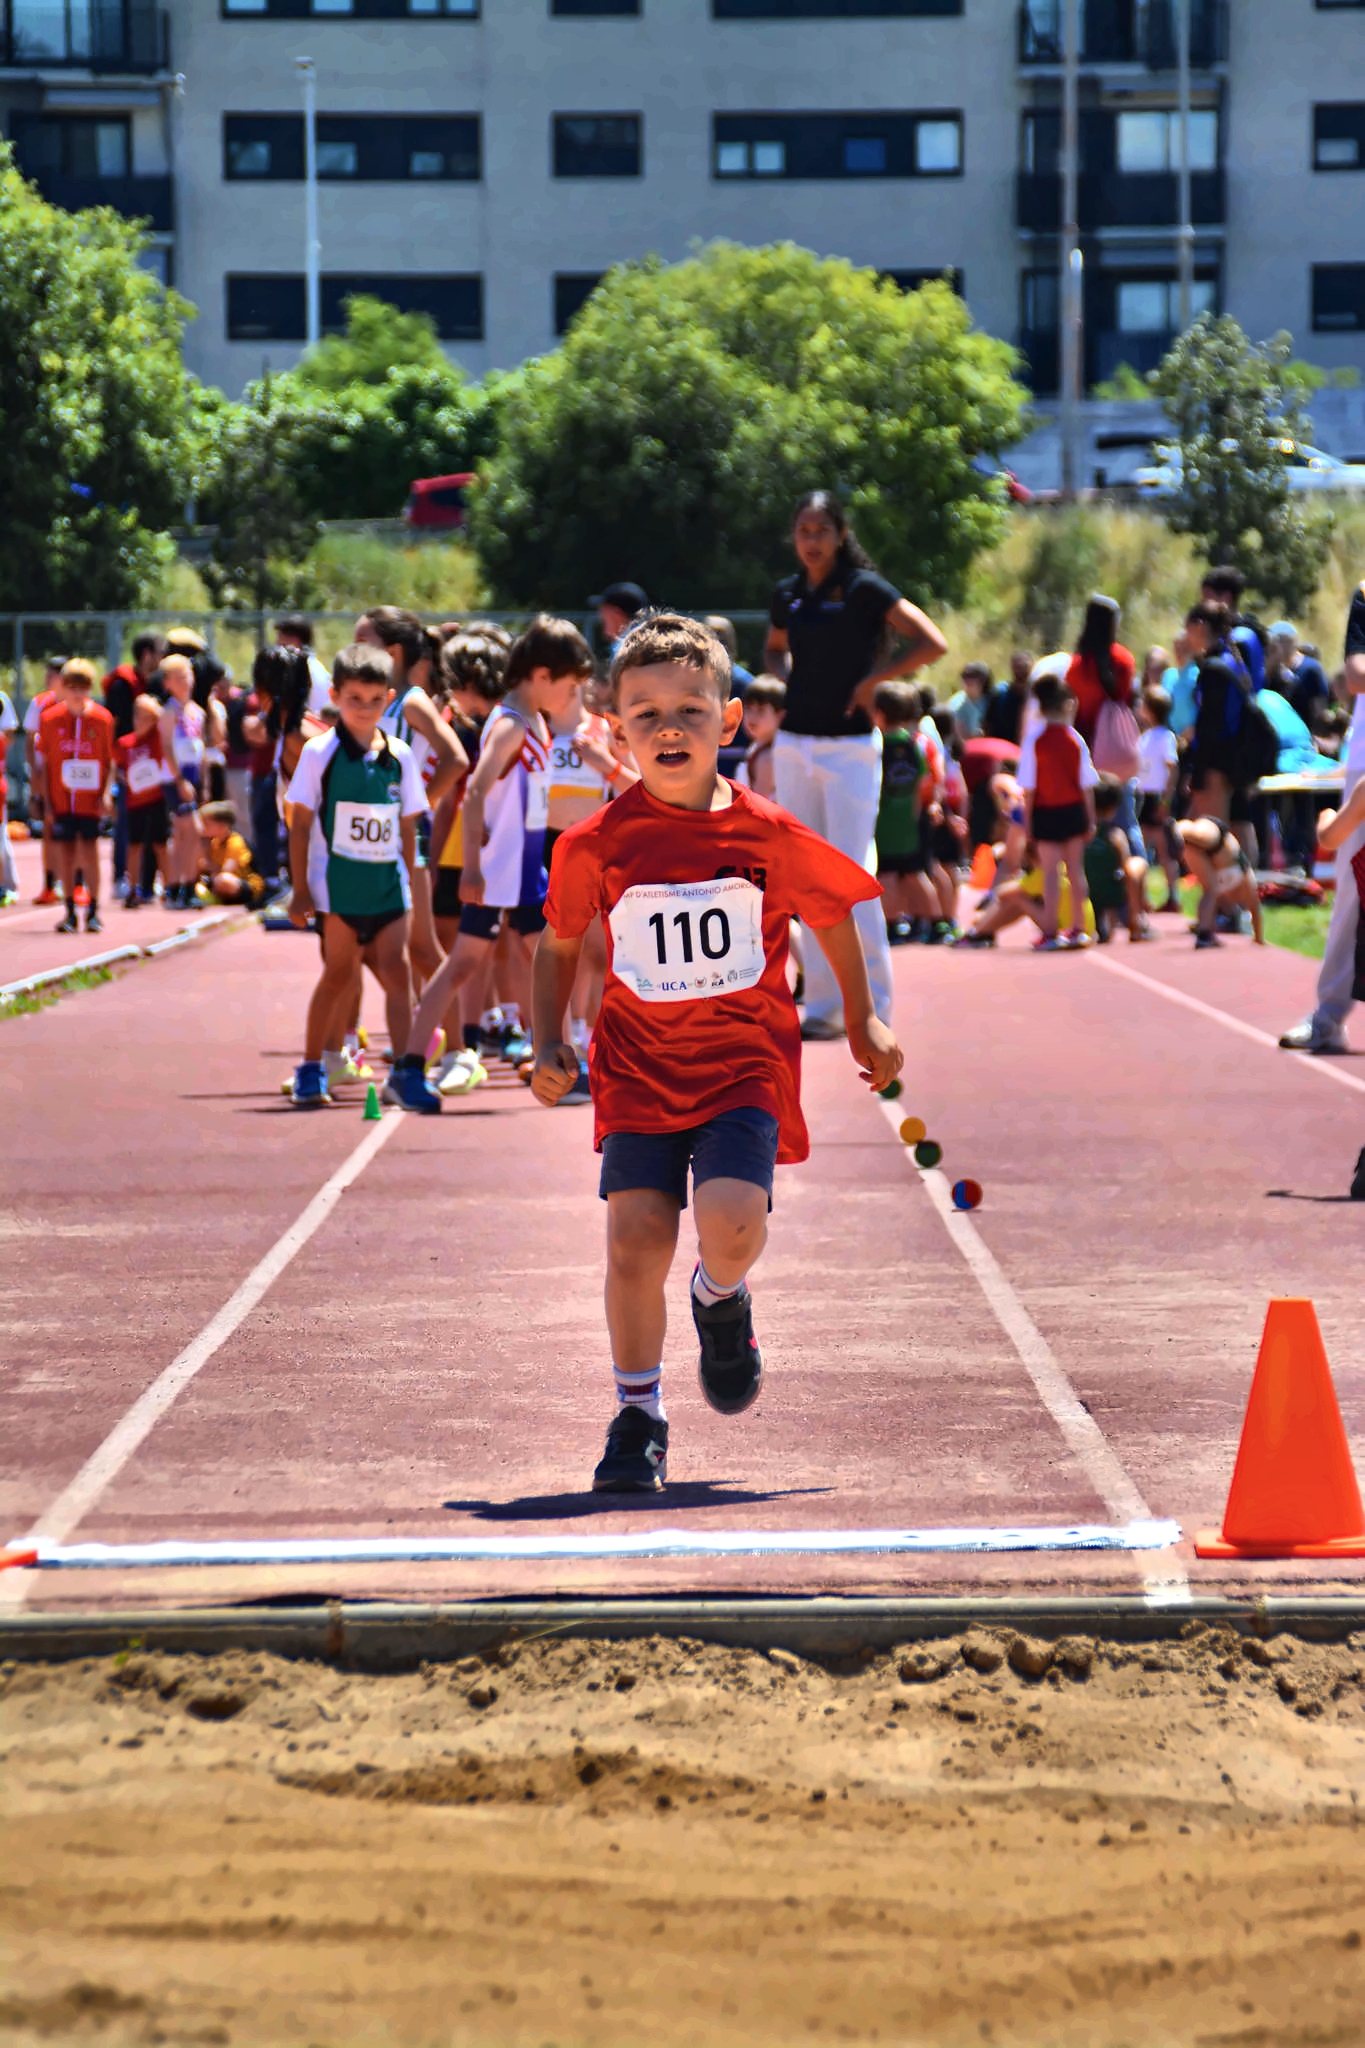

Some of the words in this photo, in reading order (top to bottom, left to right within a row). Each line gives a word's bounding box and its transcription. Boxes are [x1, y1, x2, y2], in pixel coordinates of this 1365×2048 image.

[350, 816, 392, 843] 508
[682, 886, 721, 897] ANTONIO
[649, 908, 731, 965] 110
